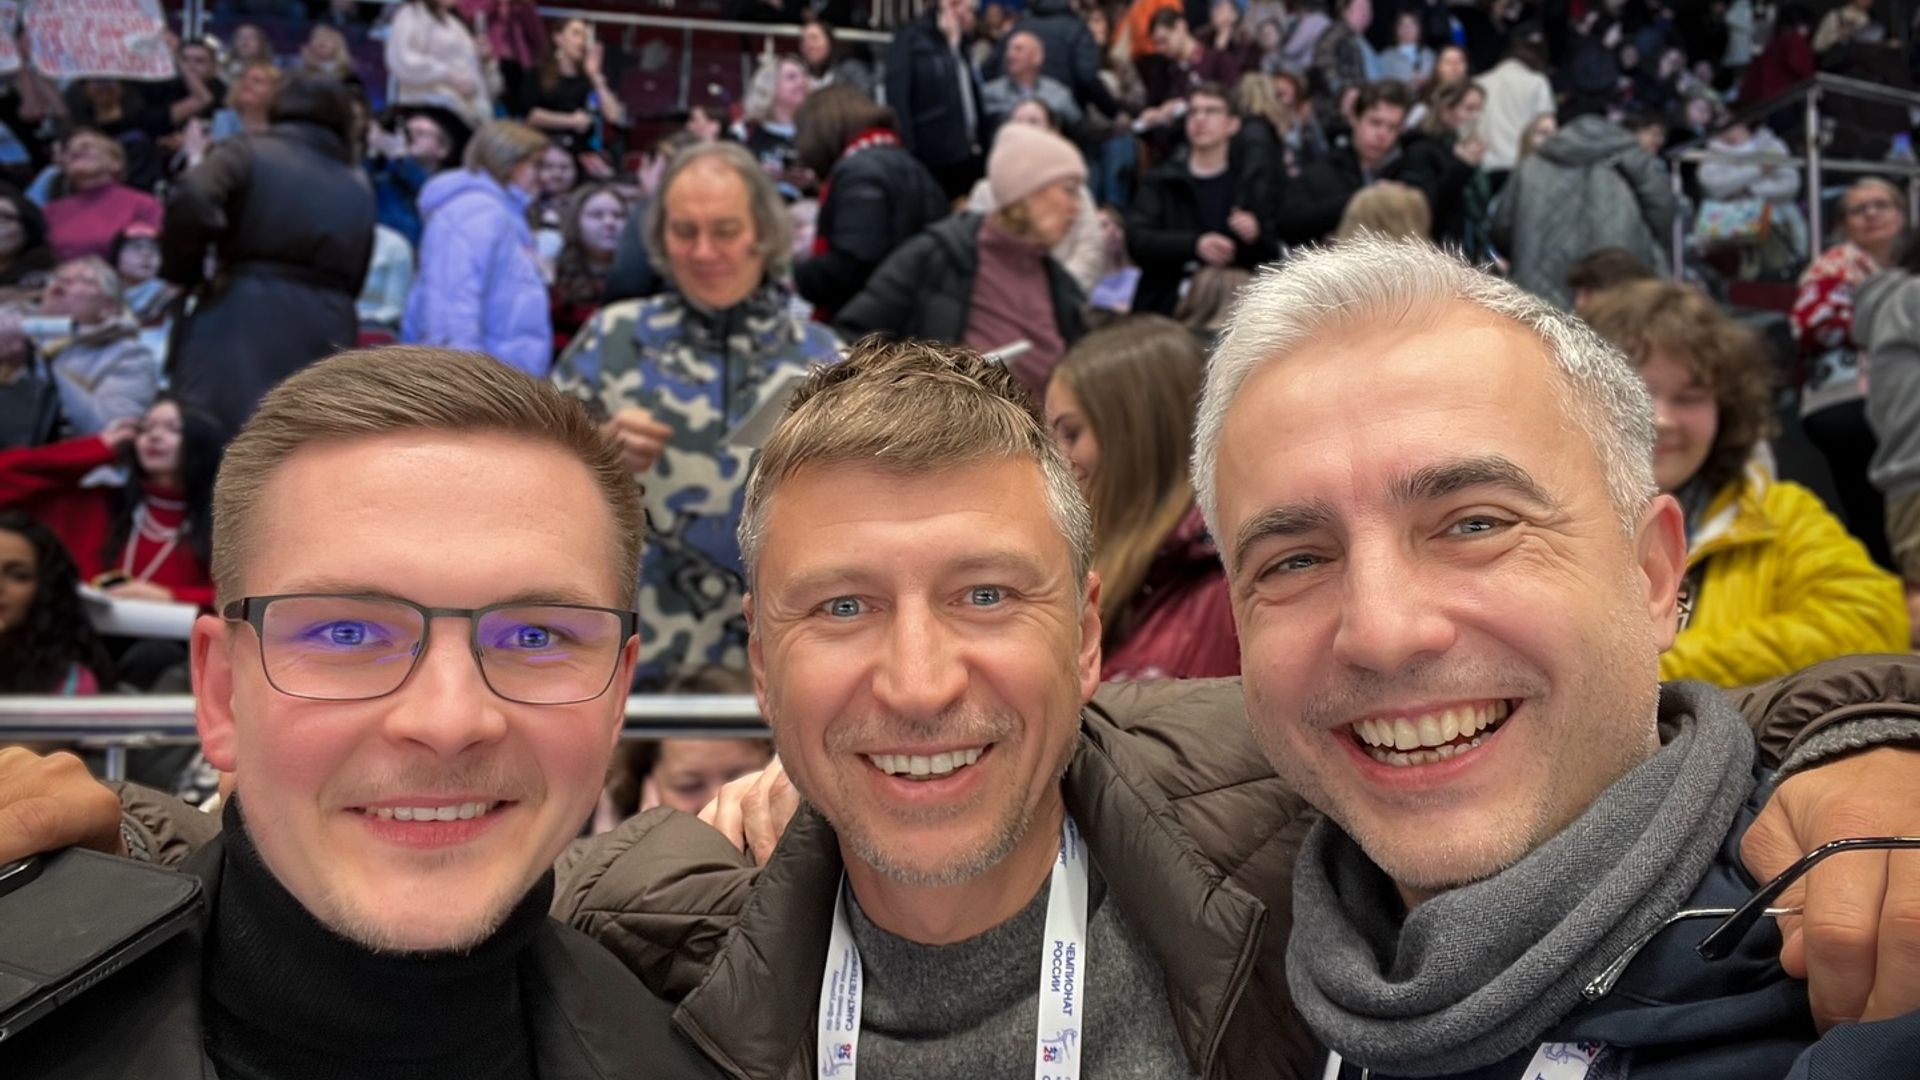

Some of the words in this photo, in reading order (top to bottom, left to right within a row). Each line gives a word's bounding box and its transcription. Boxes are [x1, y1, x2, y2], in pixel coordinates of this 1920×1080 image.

[845, 943, 858, 1031] САНКТ-ПЕТЕРБ
[1051, 940, 1063, 992] РОССИИ
[1062, 942, 1076, 1016] ЧЕМПИОНАТ
[1043, 1046, 1054, 1063] 26
